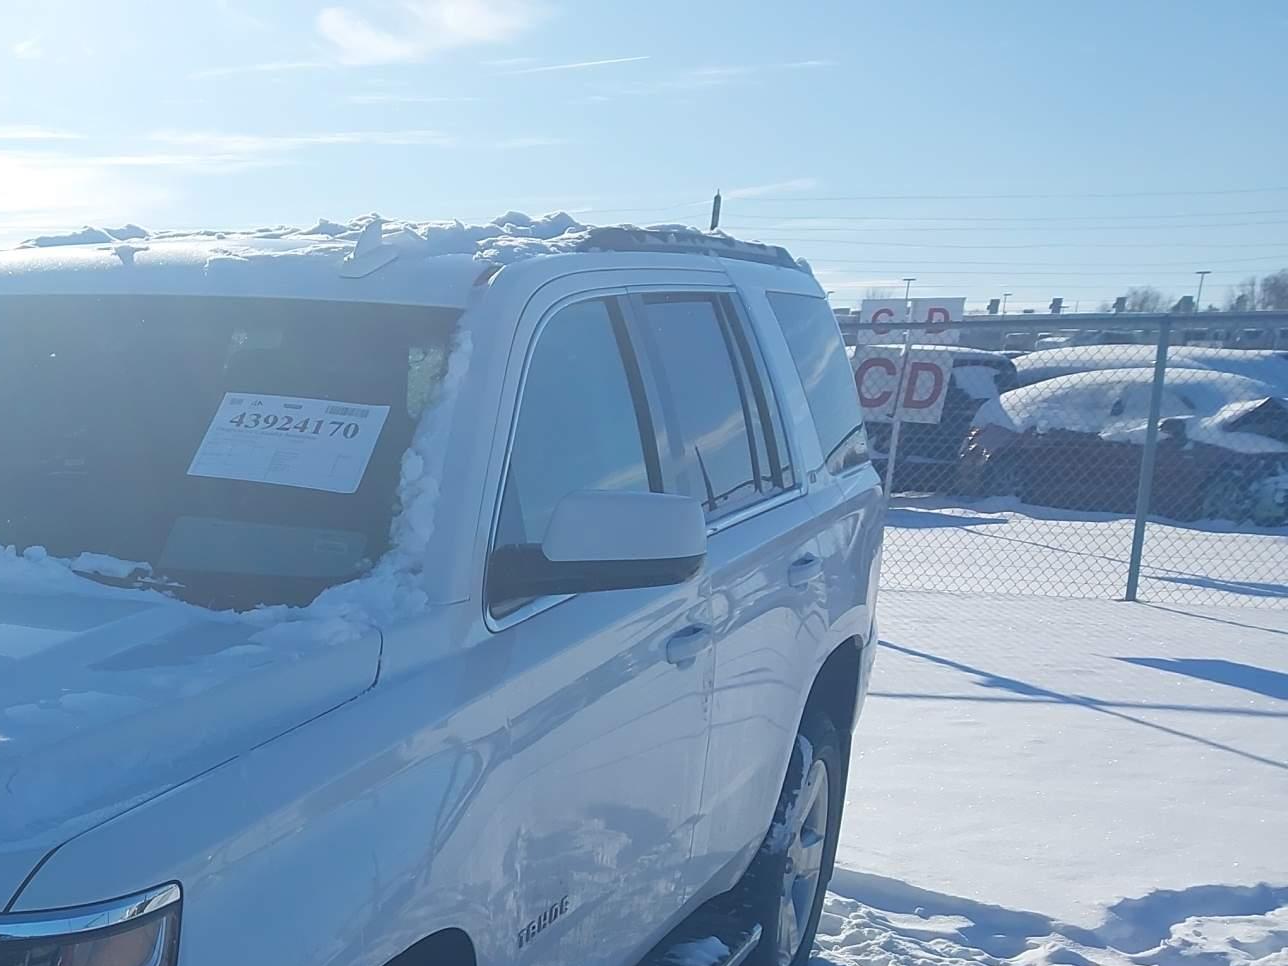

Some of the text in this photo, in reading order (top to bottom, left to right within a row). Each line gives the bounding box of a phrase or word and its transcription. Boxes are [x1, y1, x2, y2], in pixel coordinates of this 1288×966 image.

[872, 307, 951, 335] C D
[229, 411, 360, 440] 43924170
[517, 894, 570, 949] TAHOE
